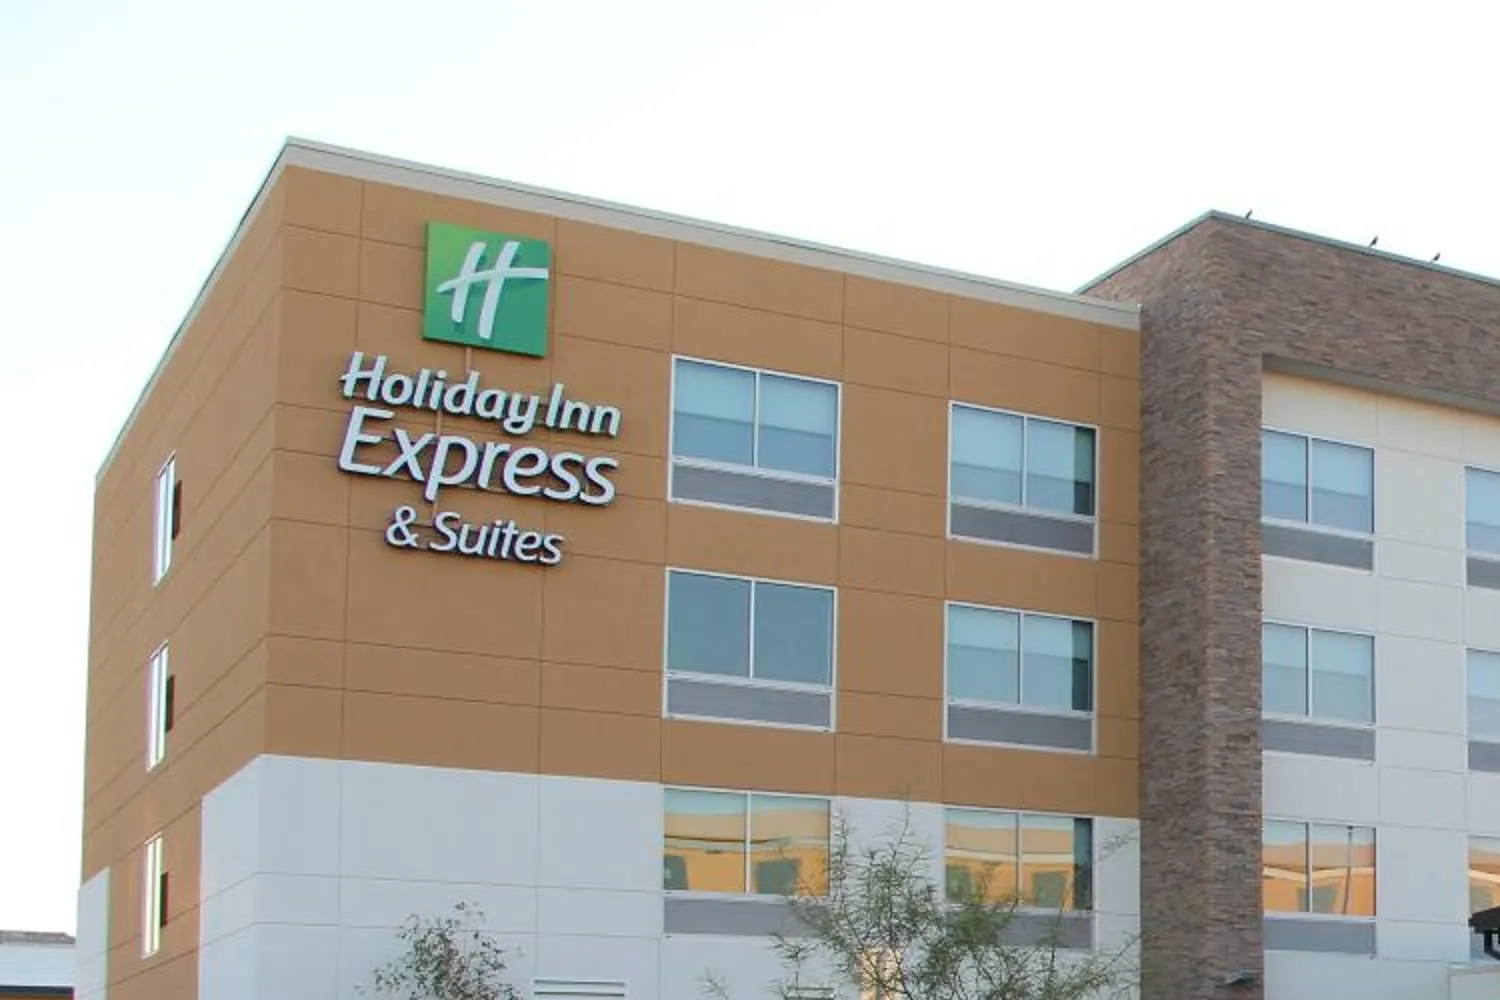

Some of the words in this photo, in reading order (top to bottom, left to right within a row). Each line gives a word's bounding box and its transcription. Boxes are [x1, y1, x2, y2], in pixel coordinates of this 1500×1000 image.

[436, 241, 549, 340] H
[340, 351, 540, 435] Holiday
[546, 383, 622, 438] Inn
[338, 405, 619, 506] Express
[385, 505, 419, 547] &
[429, 510, 565, 565] Suites
